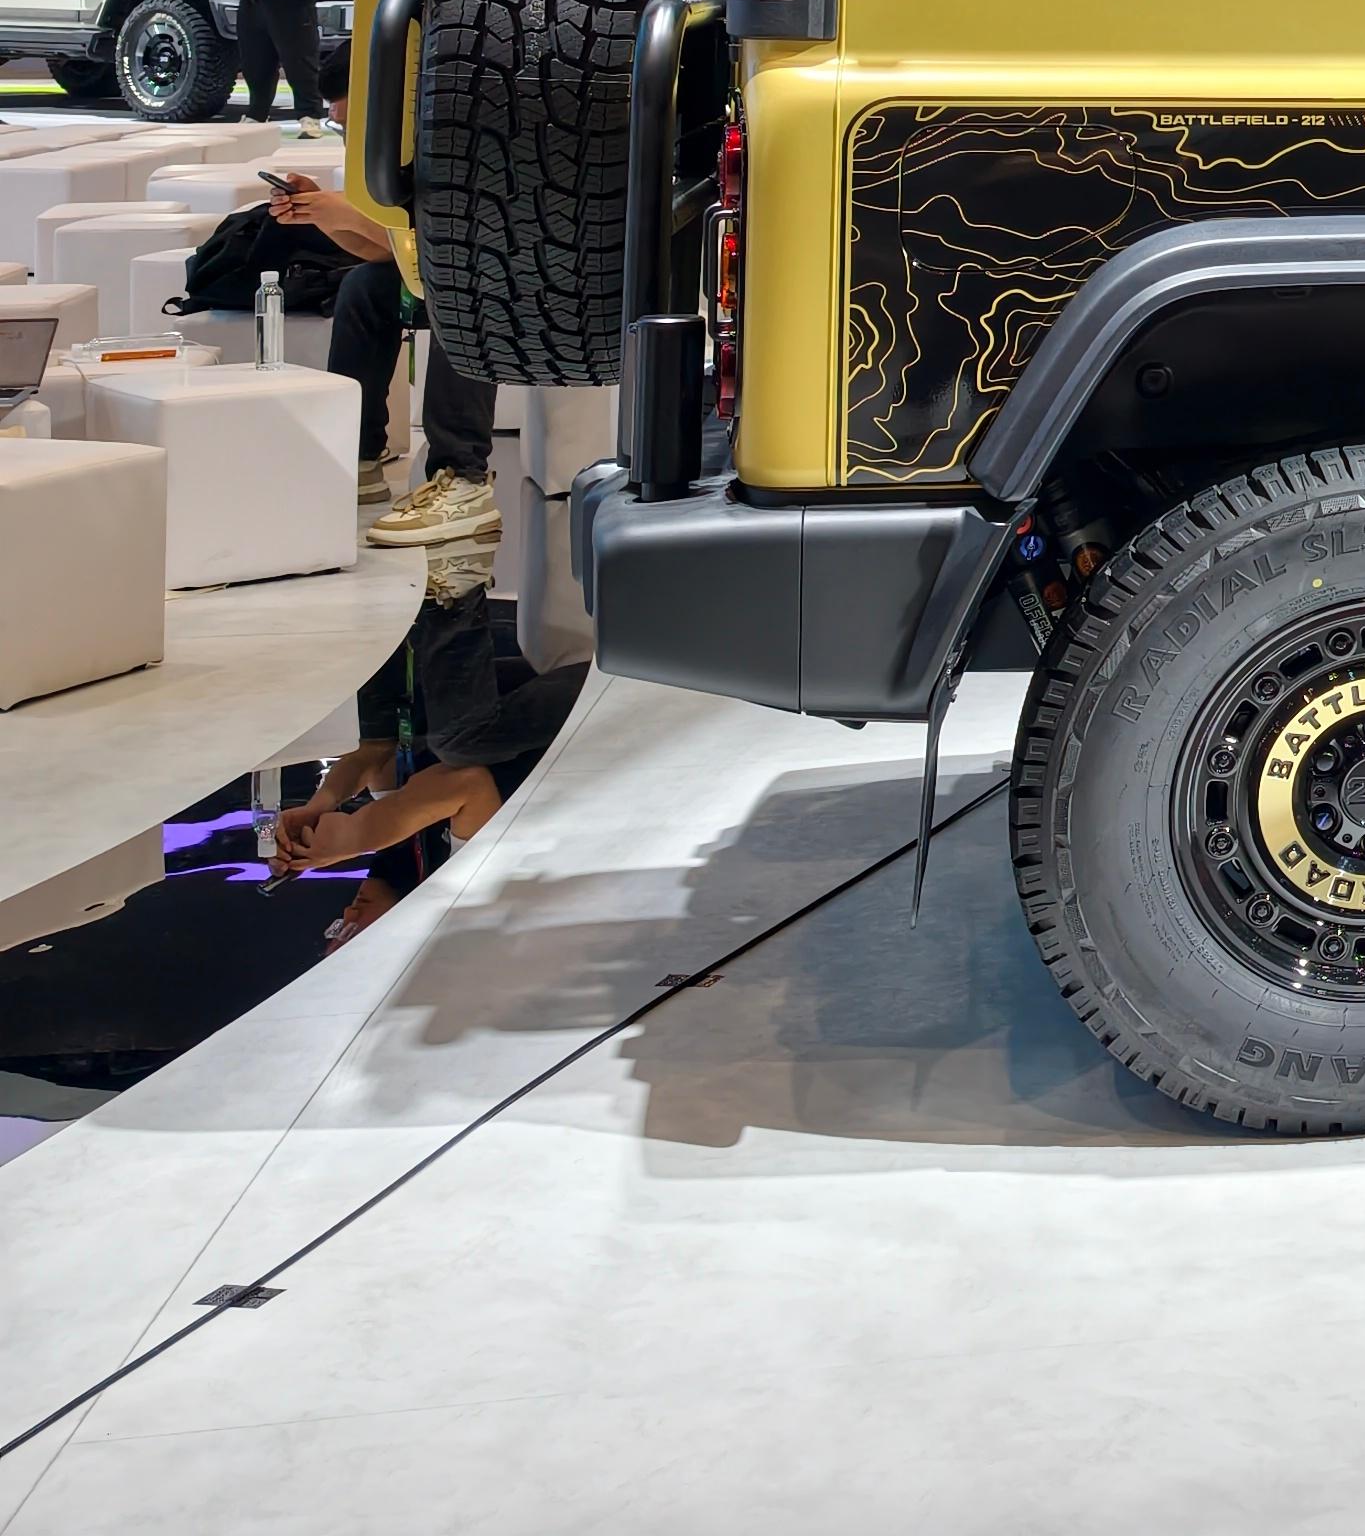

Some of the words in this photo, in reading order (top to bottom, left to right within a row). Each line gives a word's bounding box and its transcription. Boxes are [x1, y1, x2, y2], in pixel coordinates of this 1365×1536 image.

[1160, 114, 1289, 126] BATTLEFIELD
[1301, 114, 1326, 126] 212
[1111, 552, 1287, 725] RADIAL
